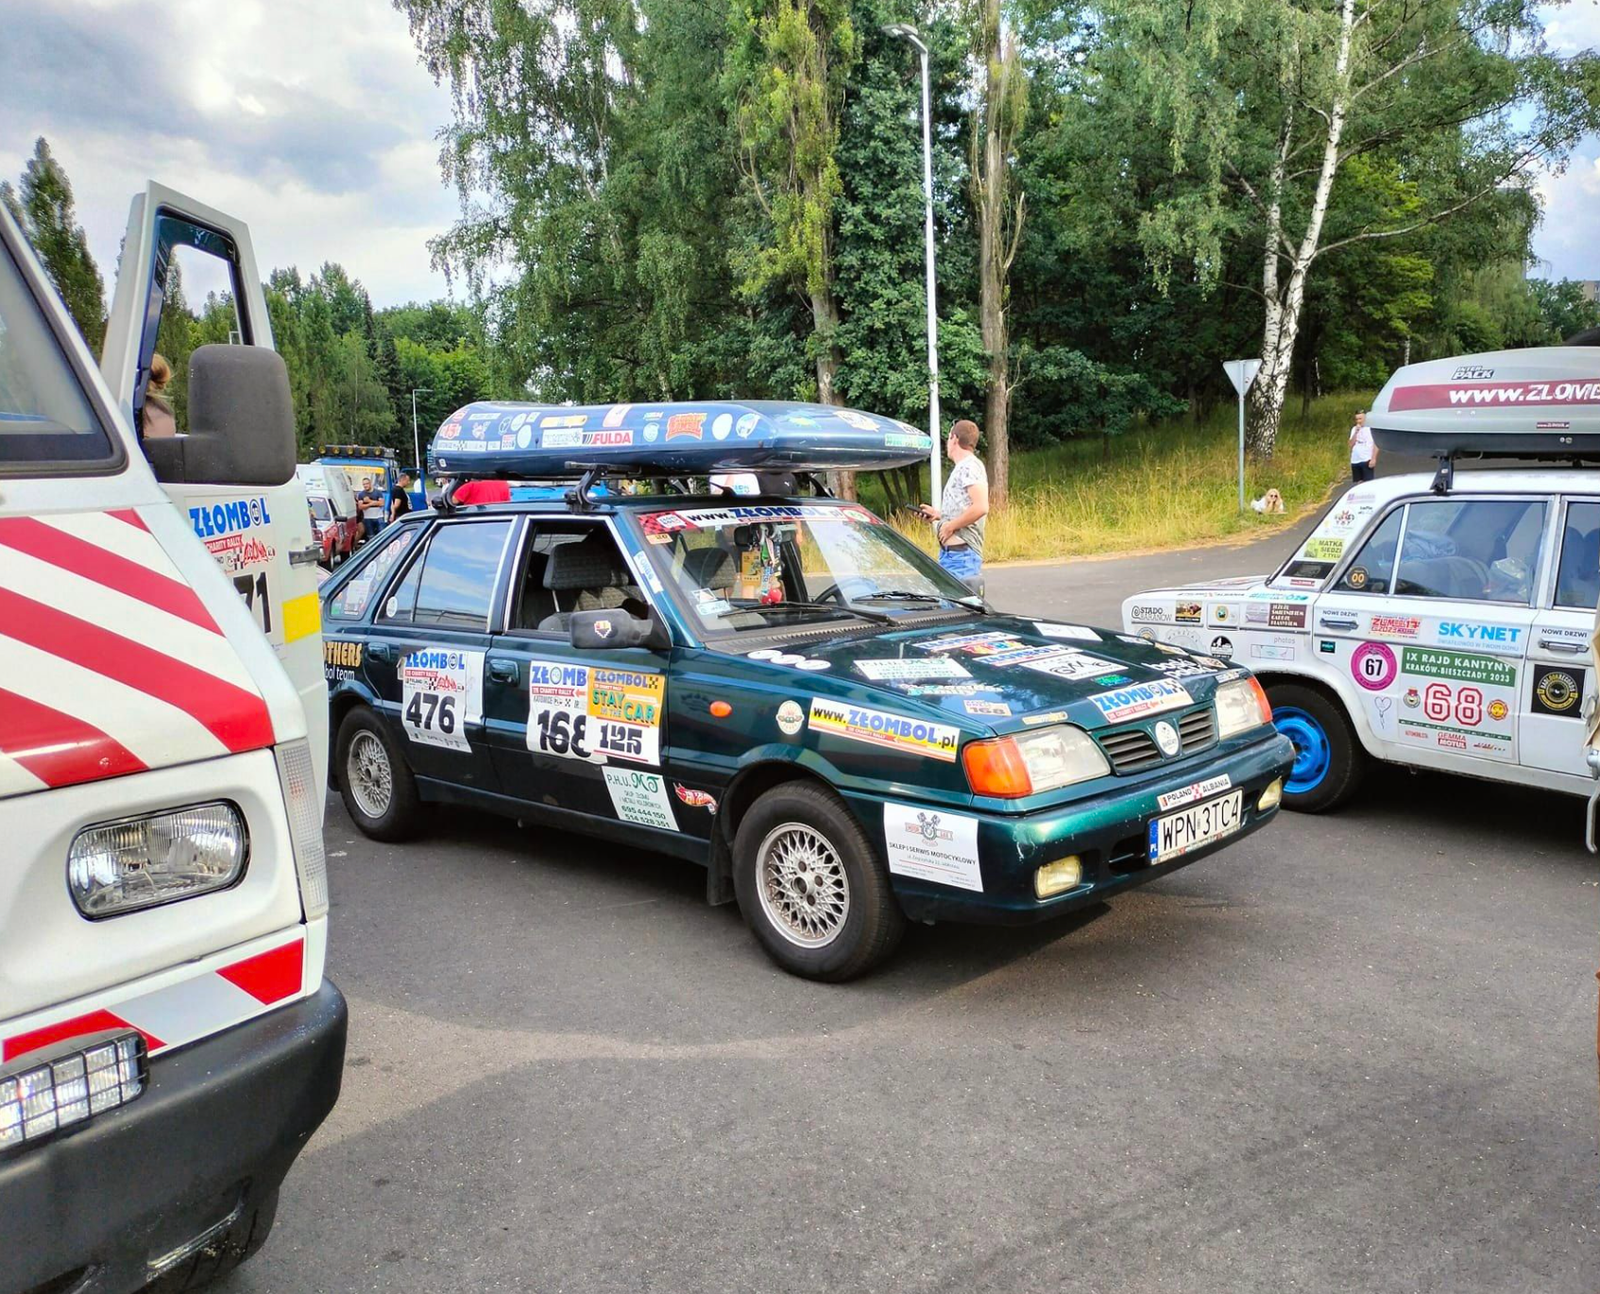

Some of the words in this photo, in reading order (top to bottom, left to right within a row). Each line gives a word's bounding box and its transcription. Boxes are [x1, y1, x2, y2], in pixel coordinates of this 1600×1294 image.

[1452, 369, 1494, 380] PACK
[591, 431, 632, 445] FULDA
[189, 497, 271, 538] ZŁOMBOL
[1351, 574, 1365, 583] 00
[1140, 606, 1163, 614] STADO
[1438, 622, 1521, 642] SKYNET
[1564, 629, 1587, 638] DRZWI
[323, 641, 362, 667] THERS
[1482, 642, 1502, 650] TWOIM
[1365, 658, 1383, 676] 67
[1406, 652, 1418, 662] IX
[1421, 653, 1450, 665] RAJD
[1454, 656, 1511, 672] KANTYNY
[336, 666, 355, 681] team
[594, 670, 648, 688] ZŁOMBOL
[1405, 662, 1487, 679] KRAKÓW-BIESZCZADY
[1489, 673, 1510, 683] 2023
[593, 689, 625, 709] STAY
[1096, 682, 1173, 711] ZŁOMBOL
[1424, 682, 1483, 727] 68
[405, 692, 456, 734] 476
[609, 707, 621, 717] THE
[624, 701, 655, 725] CAR
[813, 707, 956, 749] www.ZŁOMBOL.pl
[1437, 731, 1466, 741] GEMMA
[600, 723, 642, 755] 125
[1439, 739, 1466, 748] MOTUL
[606, 773, 631, 787] P.H.U.
[1167, 788, 1192, 802] POLAND
[1202, 778, 1229, 793] ALBANIA
[621, 805, 637, 814] 695
[637, 807, 652, 817] 444
[653, 811, 666, 820] 150
[625, 813, 639, 822] 514
[641, 816, 655, 825] 528
[656, 819, 671, 828] 351
[1163, 811, 1196, 851] WPN
[1202, 795, 1239, 835] 3TC4
[889, 842, 906, 850] SKLEP
[909, 847, 930, 856] SERWIS
[930, 851, 976, 866] MOTOCYKLOWY
